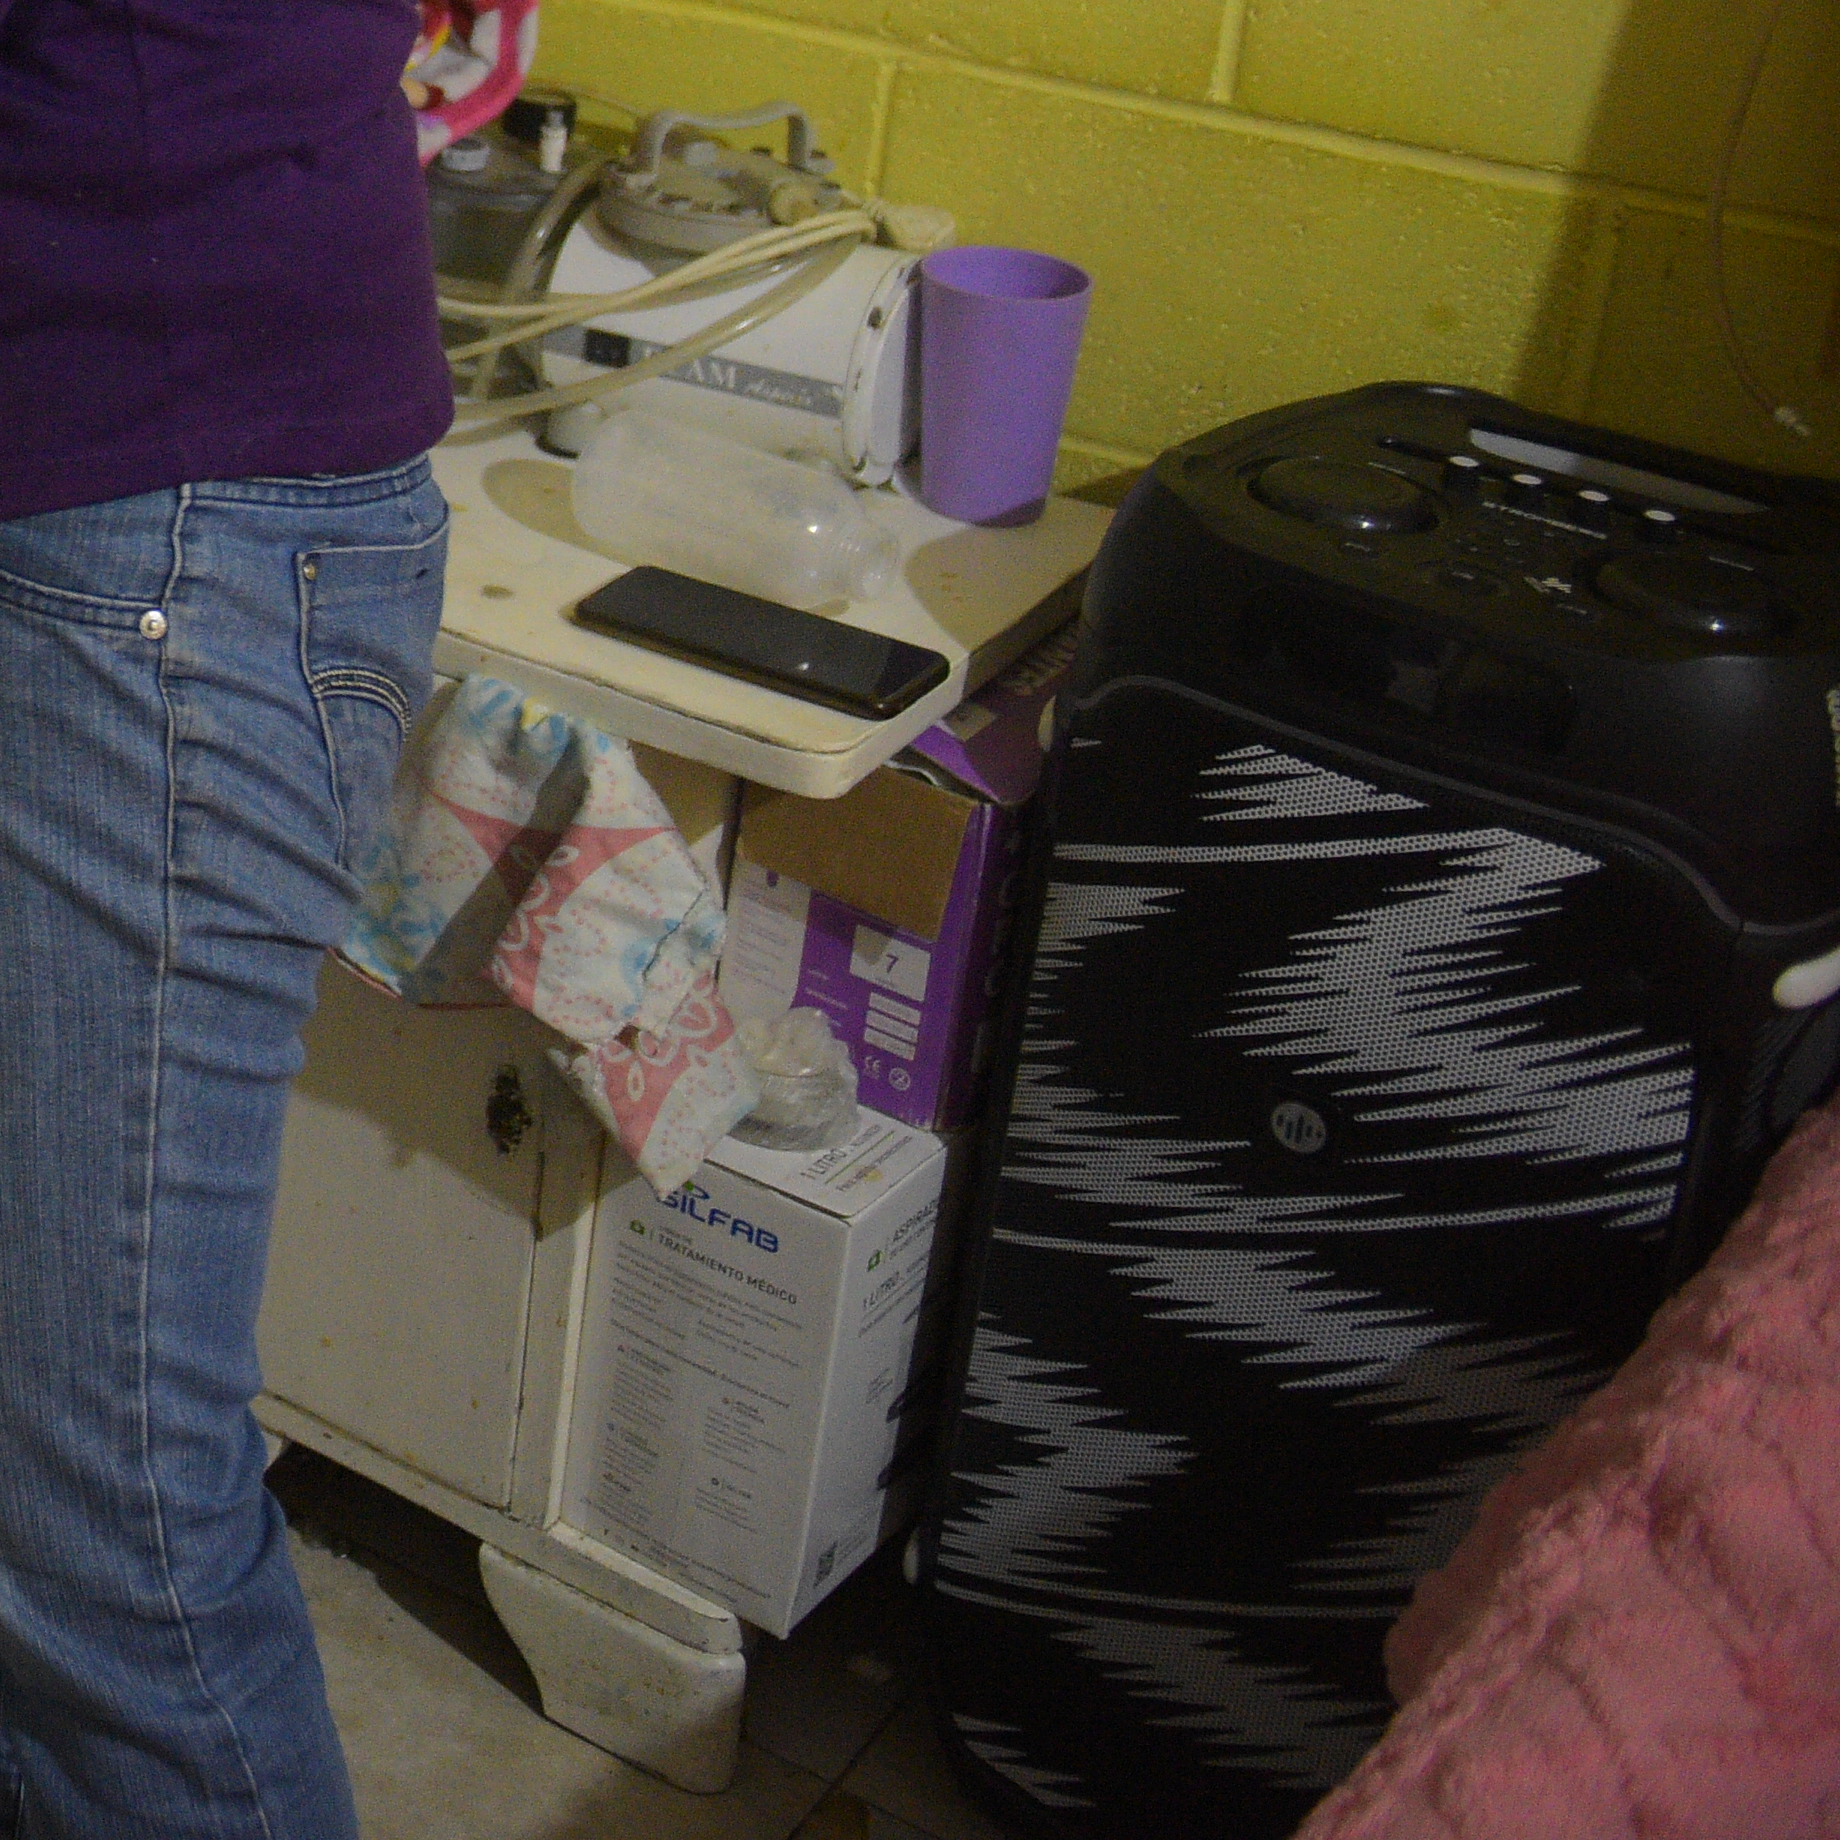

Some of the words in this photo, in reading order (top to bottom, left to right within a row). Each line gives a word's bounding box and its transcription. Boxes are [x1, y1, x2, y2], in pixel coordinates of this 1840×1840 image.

[886, 953, 899, 974] 7
[658, 1233, 744, 1282] TRATAMIENTO
[746, 1274, 798, 1306] MÉDICO
